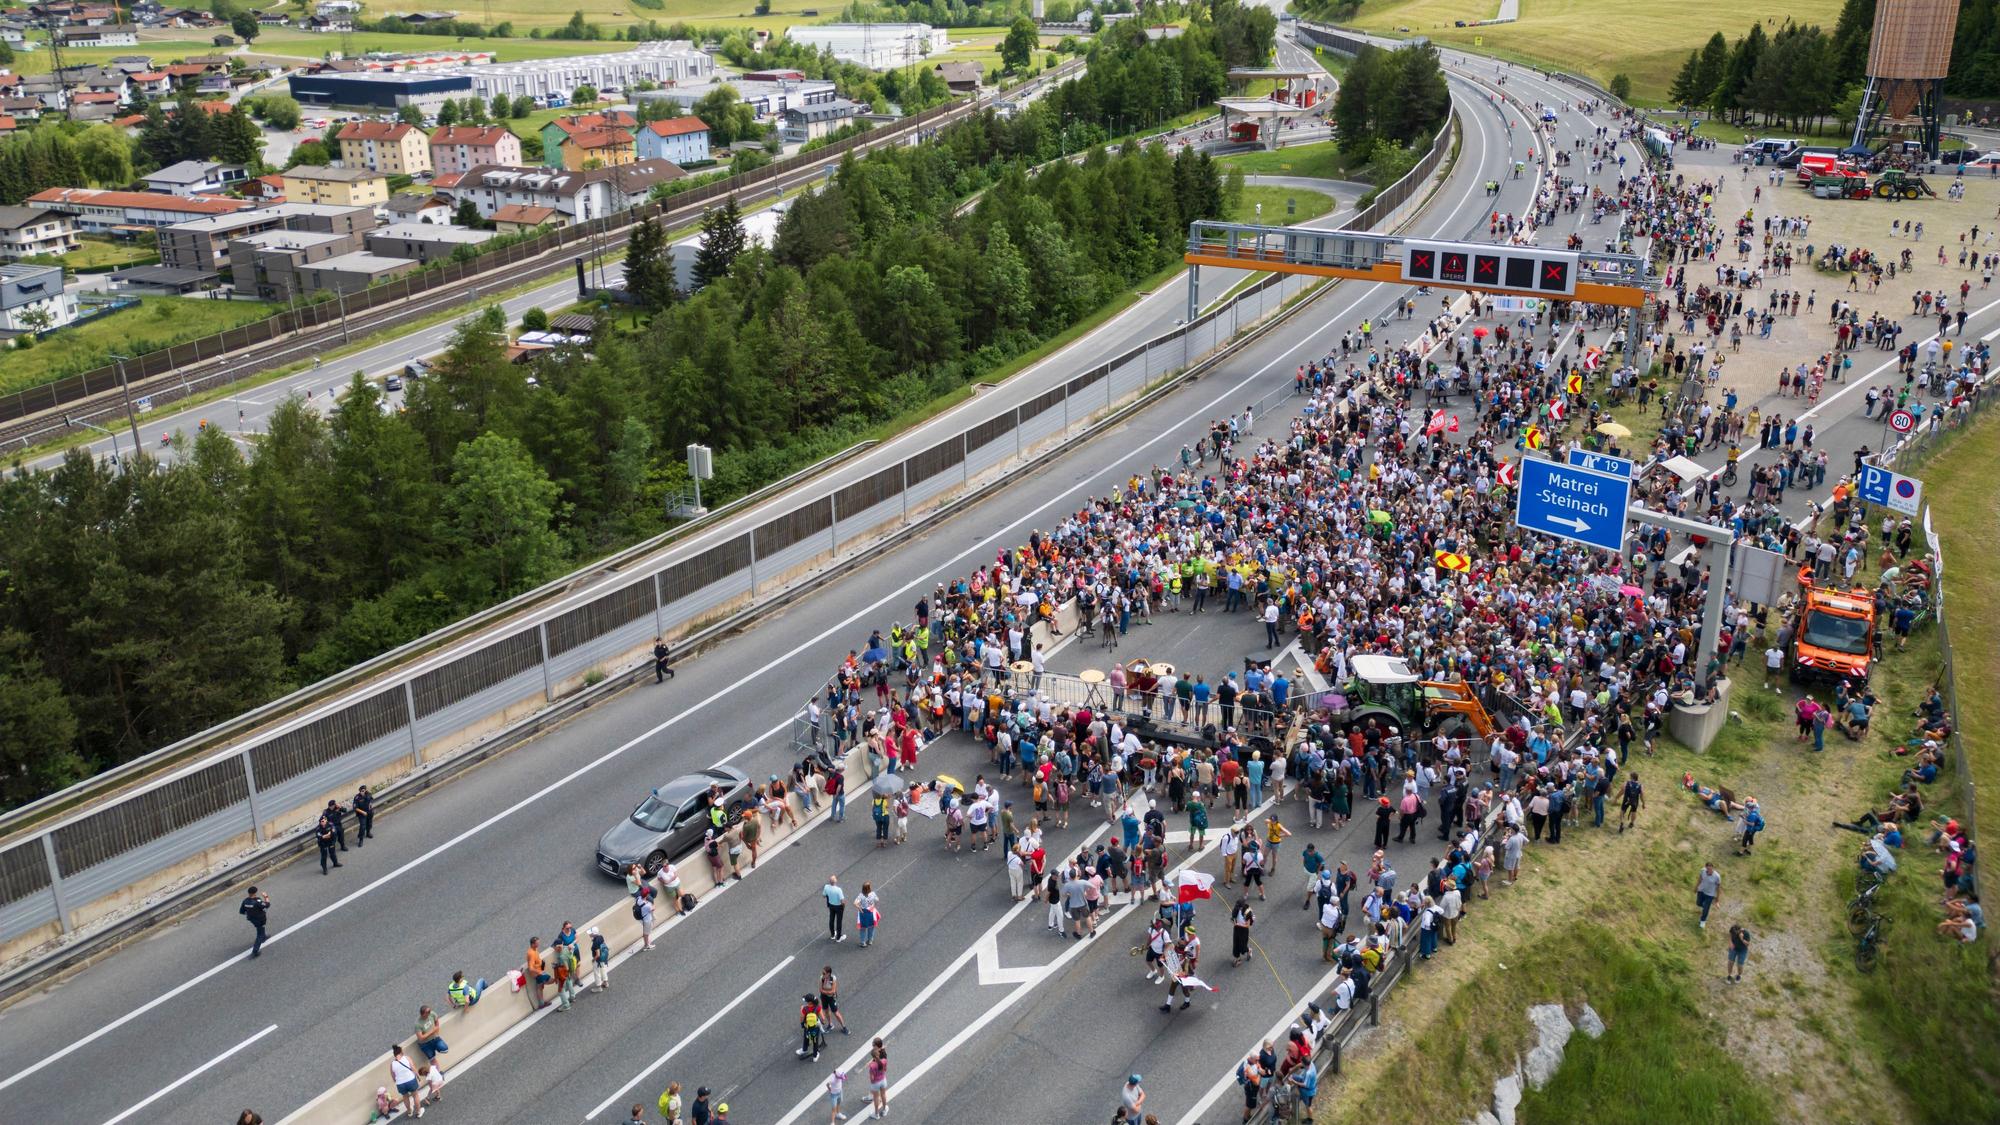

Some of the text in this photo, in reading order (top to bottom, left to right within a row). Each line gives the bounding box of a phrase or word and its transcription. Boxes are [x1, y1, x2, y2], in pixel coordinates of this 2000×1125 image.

[1894, 415, 1908, 427] 80
[1605, 460, 1619, 472] 19
[1548, 472, 1599, 496] Matrei
[1865, 467, 1881, 490] P
[1536, 489, 1608, 517] -Steinach
